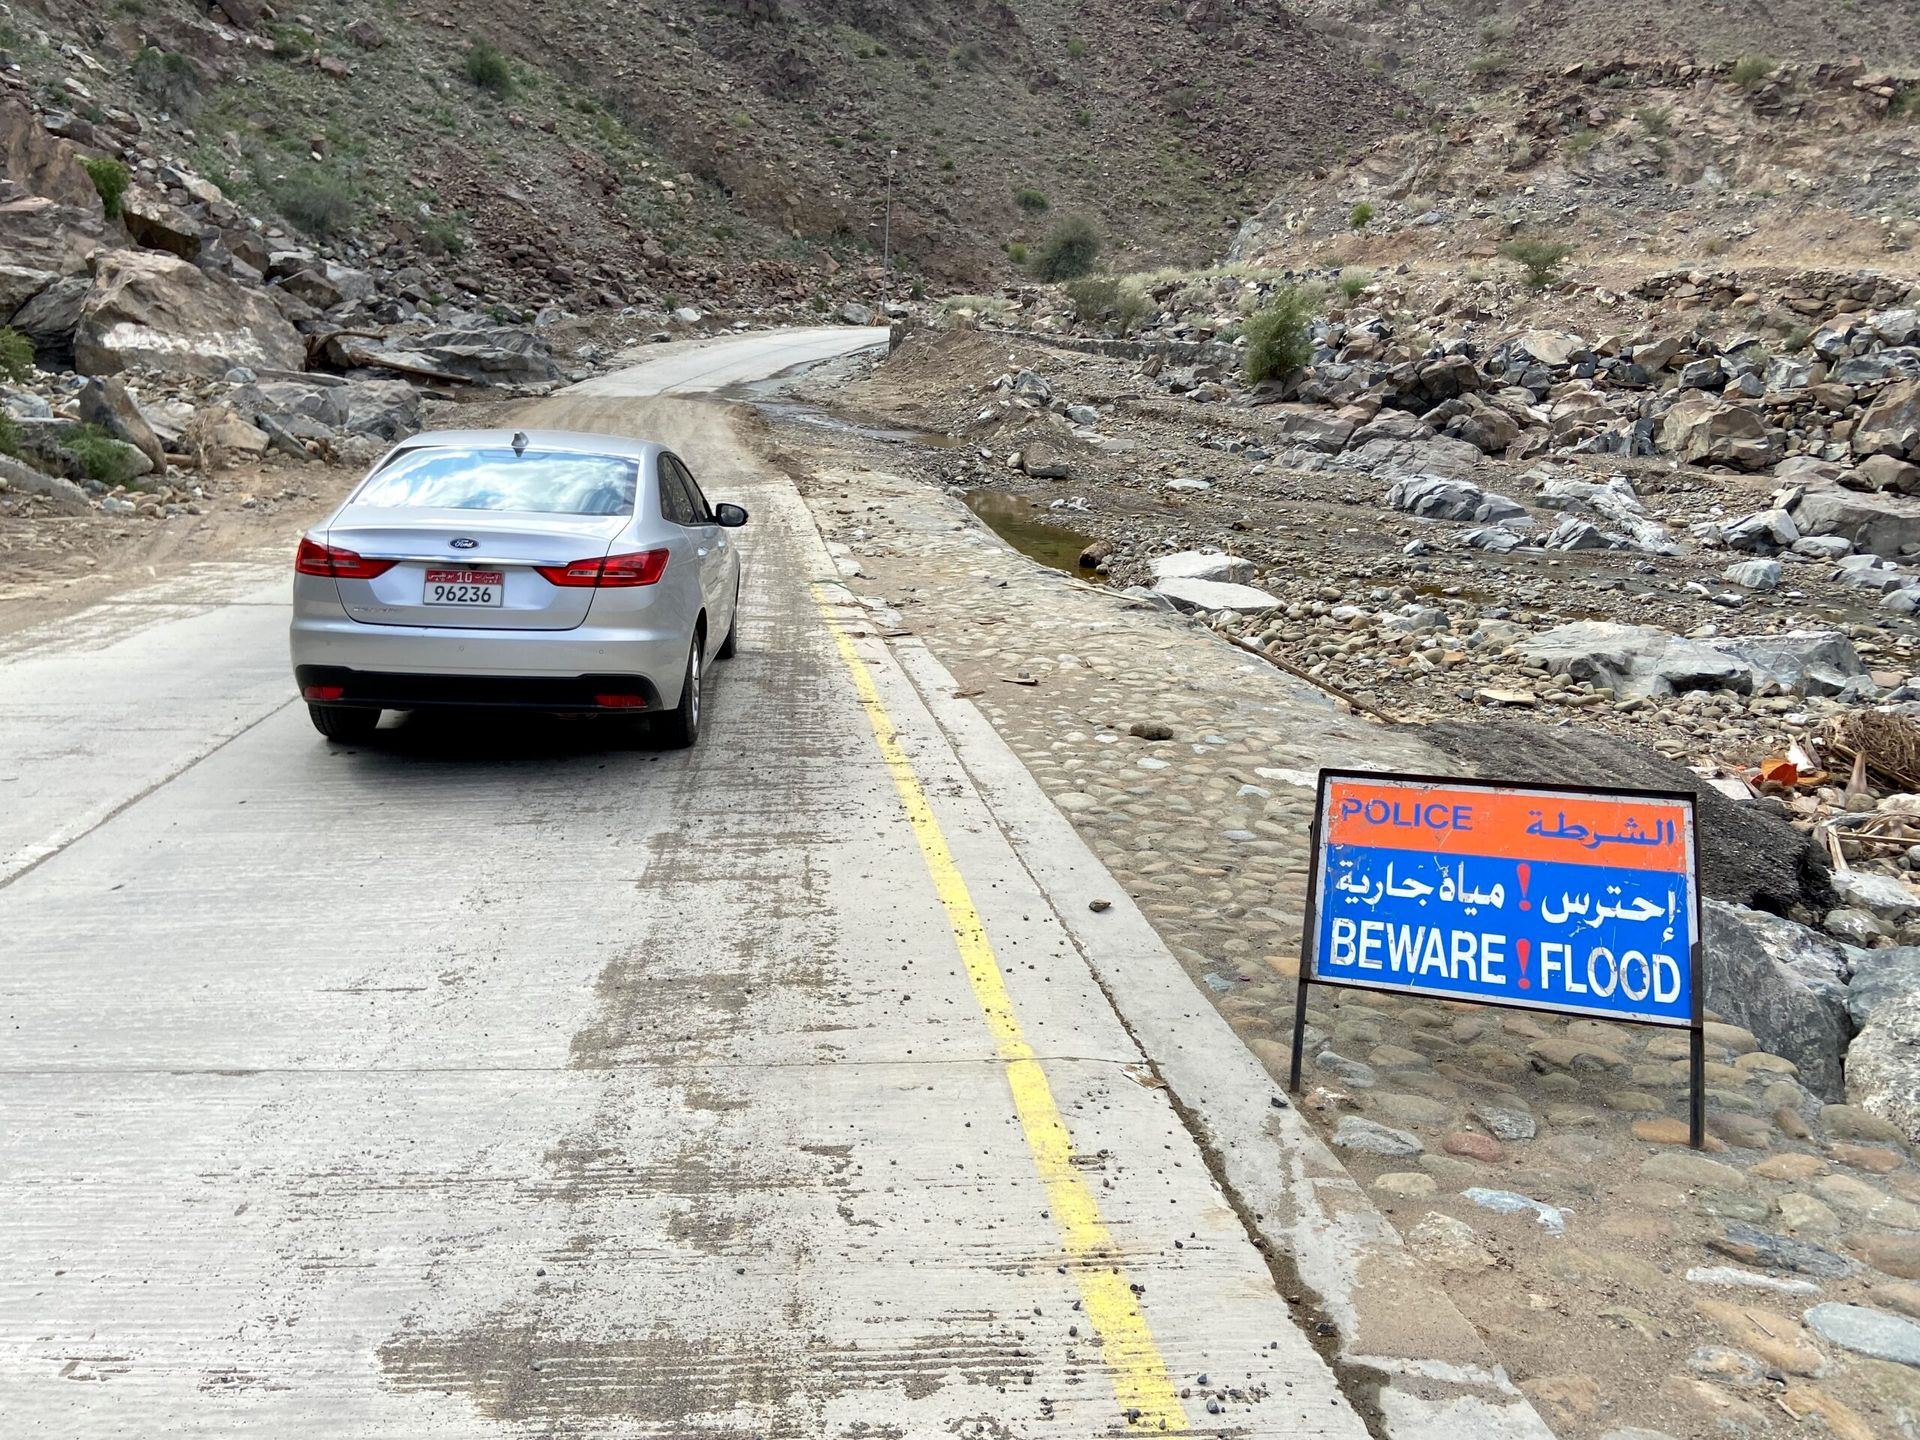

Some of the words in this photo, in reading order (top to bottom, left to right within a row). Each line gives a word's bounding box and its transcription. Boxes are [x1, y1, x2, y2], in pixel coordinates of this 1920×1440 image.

[435, 585, 491, 602] 96236
[457, 572, 472, 583] 10
[1341, 798, 1473, 831] POLICE
[1526, 810, 1675, 849] الشرطة
[1540, 942, 1681, 1004] FLOOD
